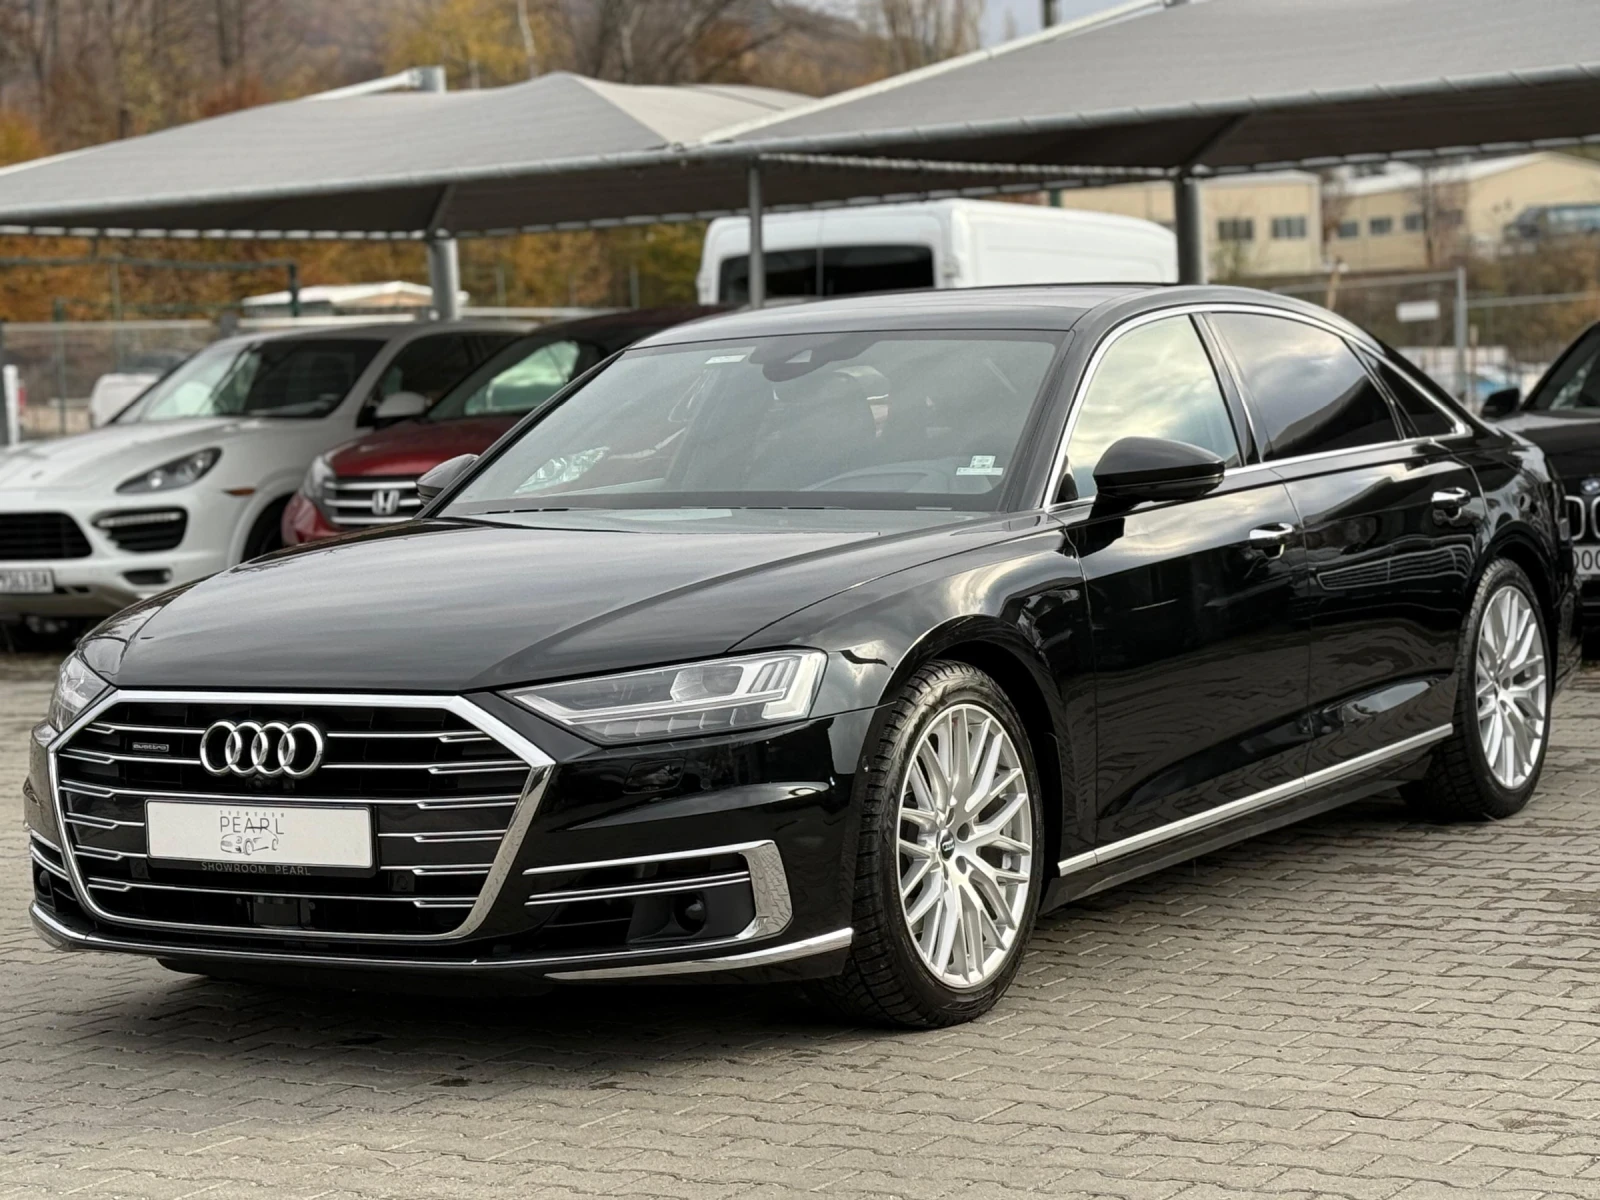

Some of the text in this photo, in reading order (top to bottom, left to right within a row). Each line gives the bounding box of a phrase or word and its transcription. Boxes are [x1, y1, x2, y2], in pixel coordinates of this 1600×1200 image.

[220, 816, 284, 834] PEARL
[201, 862, 311, 876] SHOWROOM PEARL
